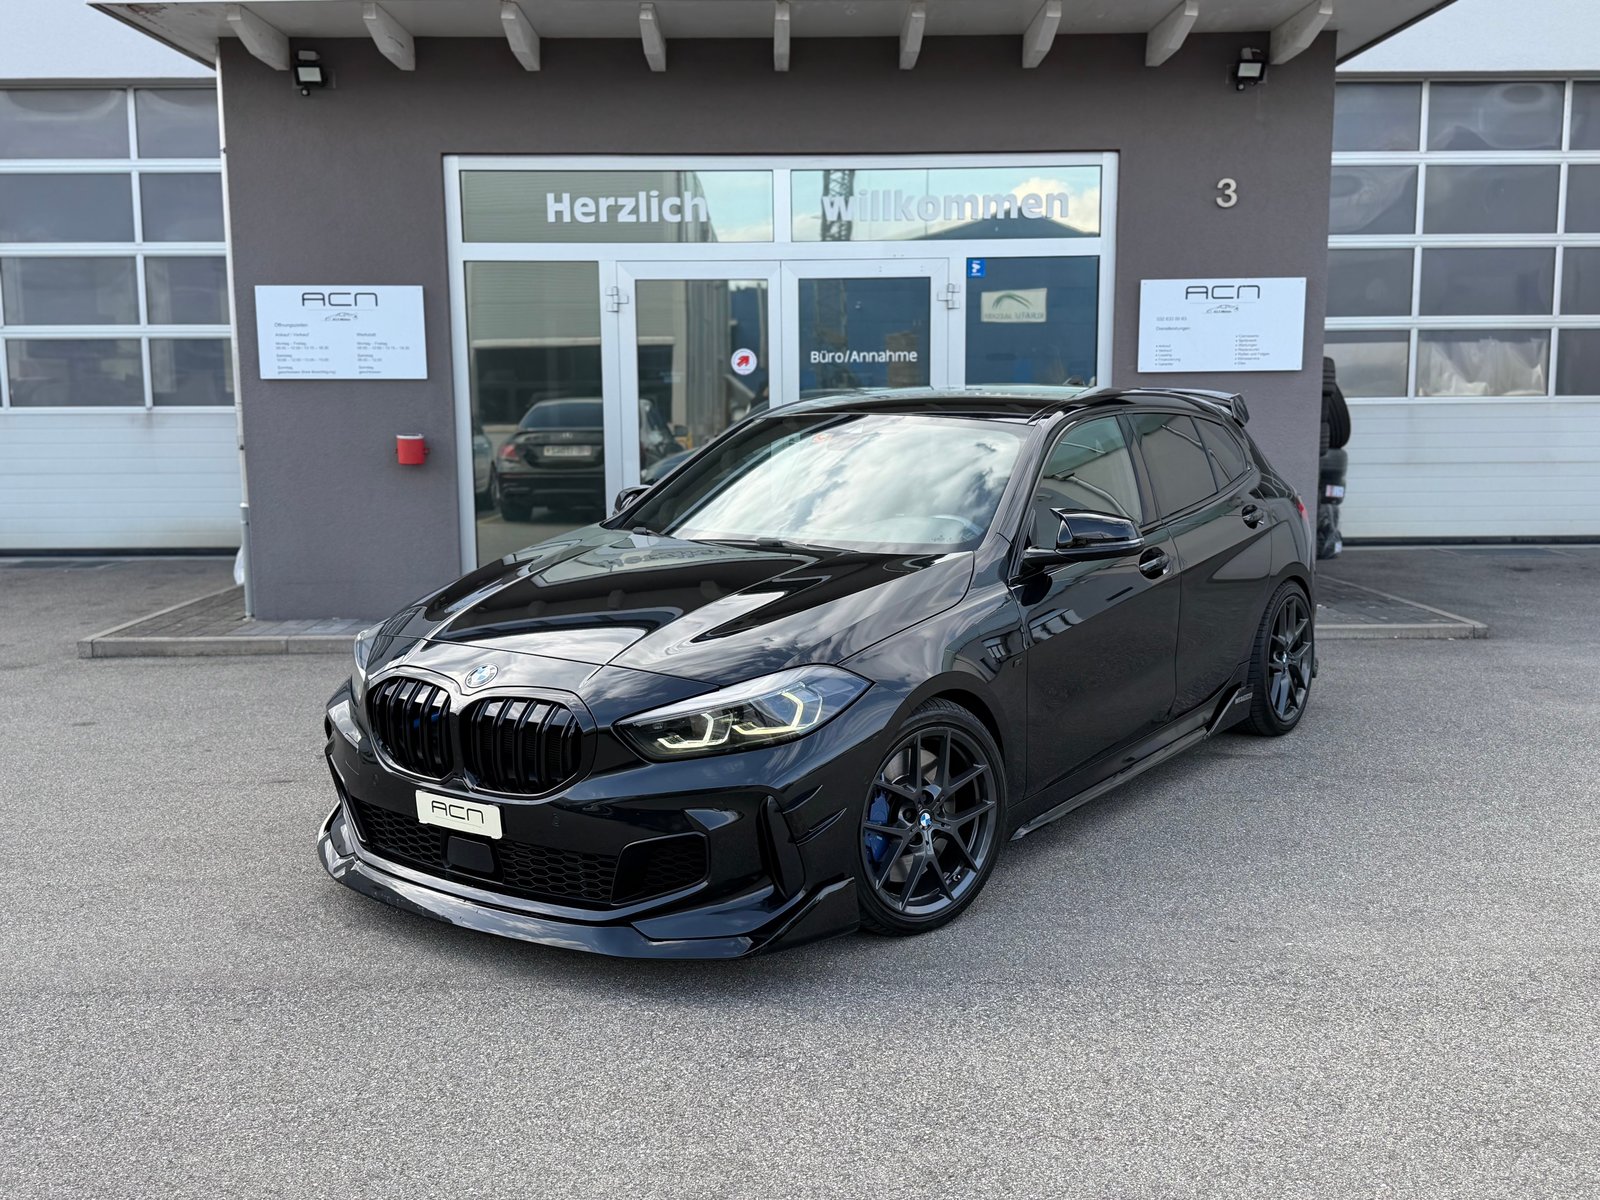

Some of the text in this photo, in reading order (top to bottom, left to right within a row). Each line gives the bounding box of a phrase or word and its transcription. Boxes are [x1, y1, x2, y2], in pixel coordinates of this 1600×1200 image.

[1215, 178, 1239, 208] 3
[546, 189, 1070, 223] Herzlich willkommen
[301, 292, 379, 307] ACN
[1184, 284, 1261, 300] ACN
[810, 349, 918, 364] Büro/Annahme
[431, 800, 485, 824] ACN
